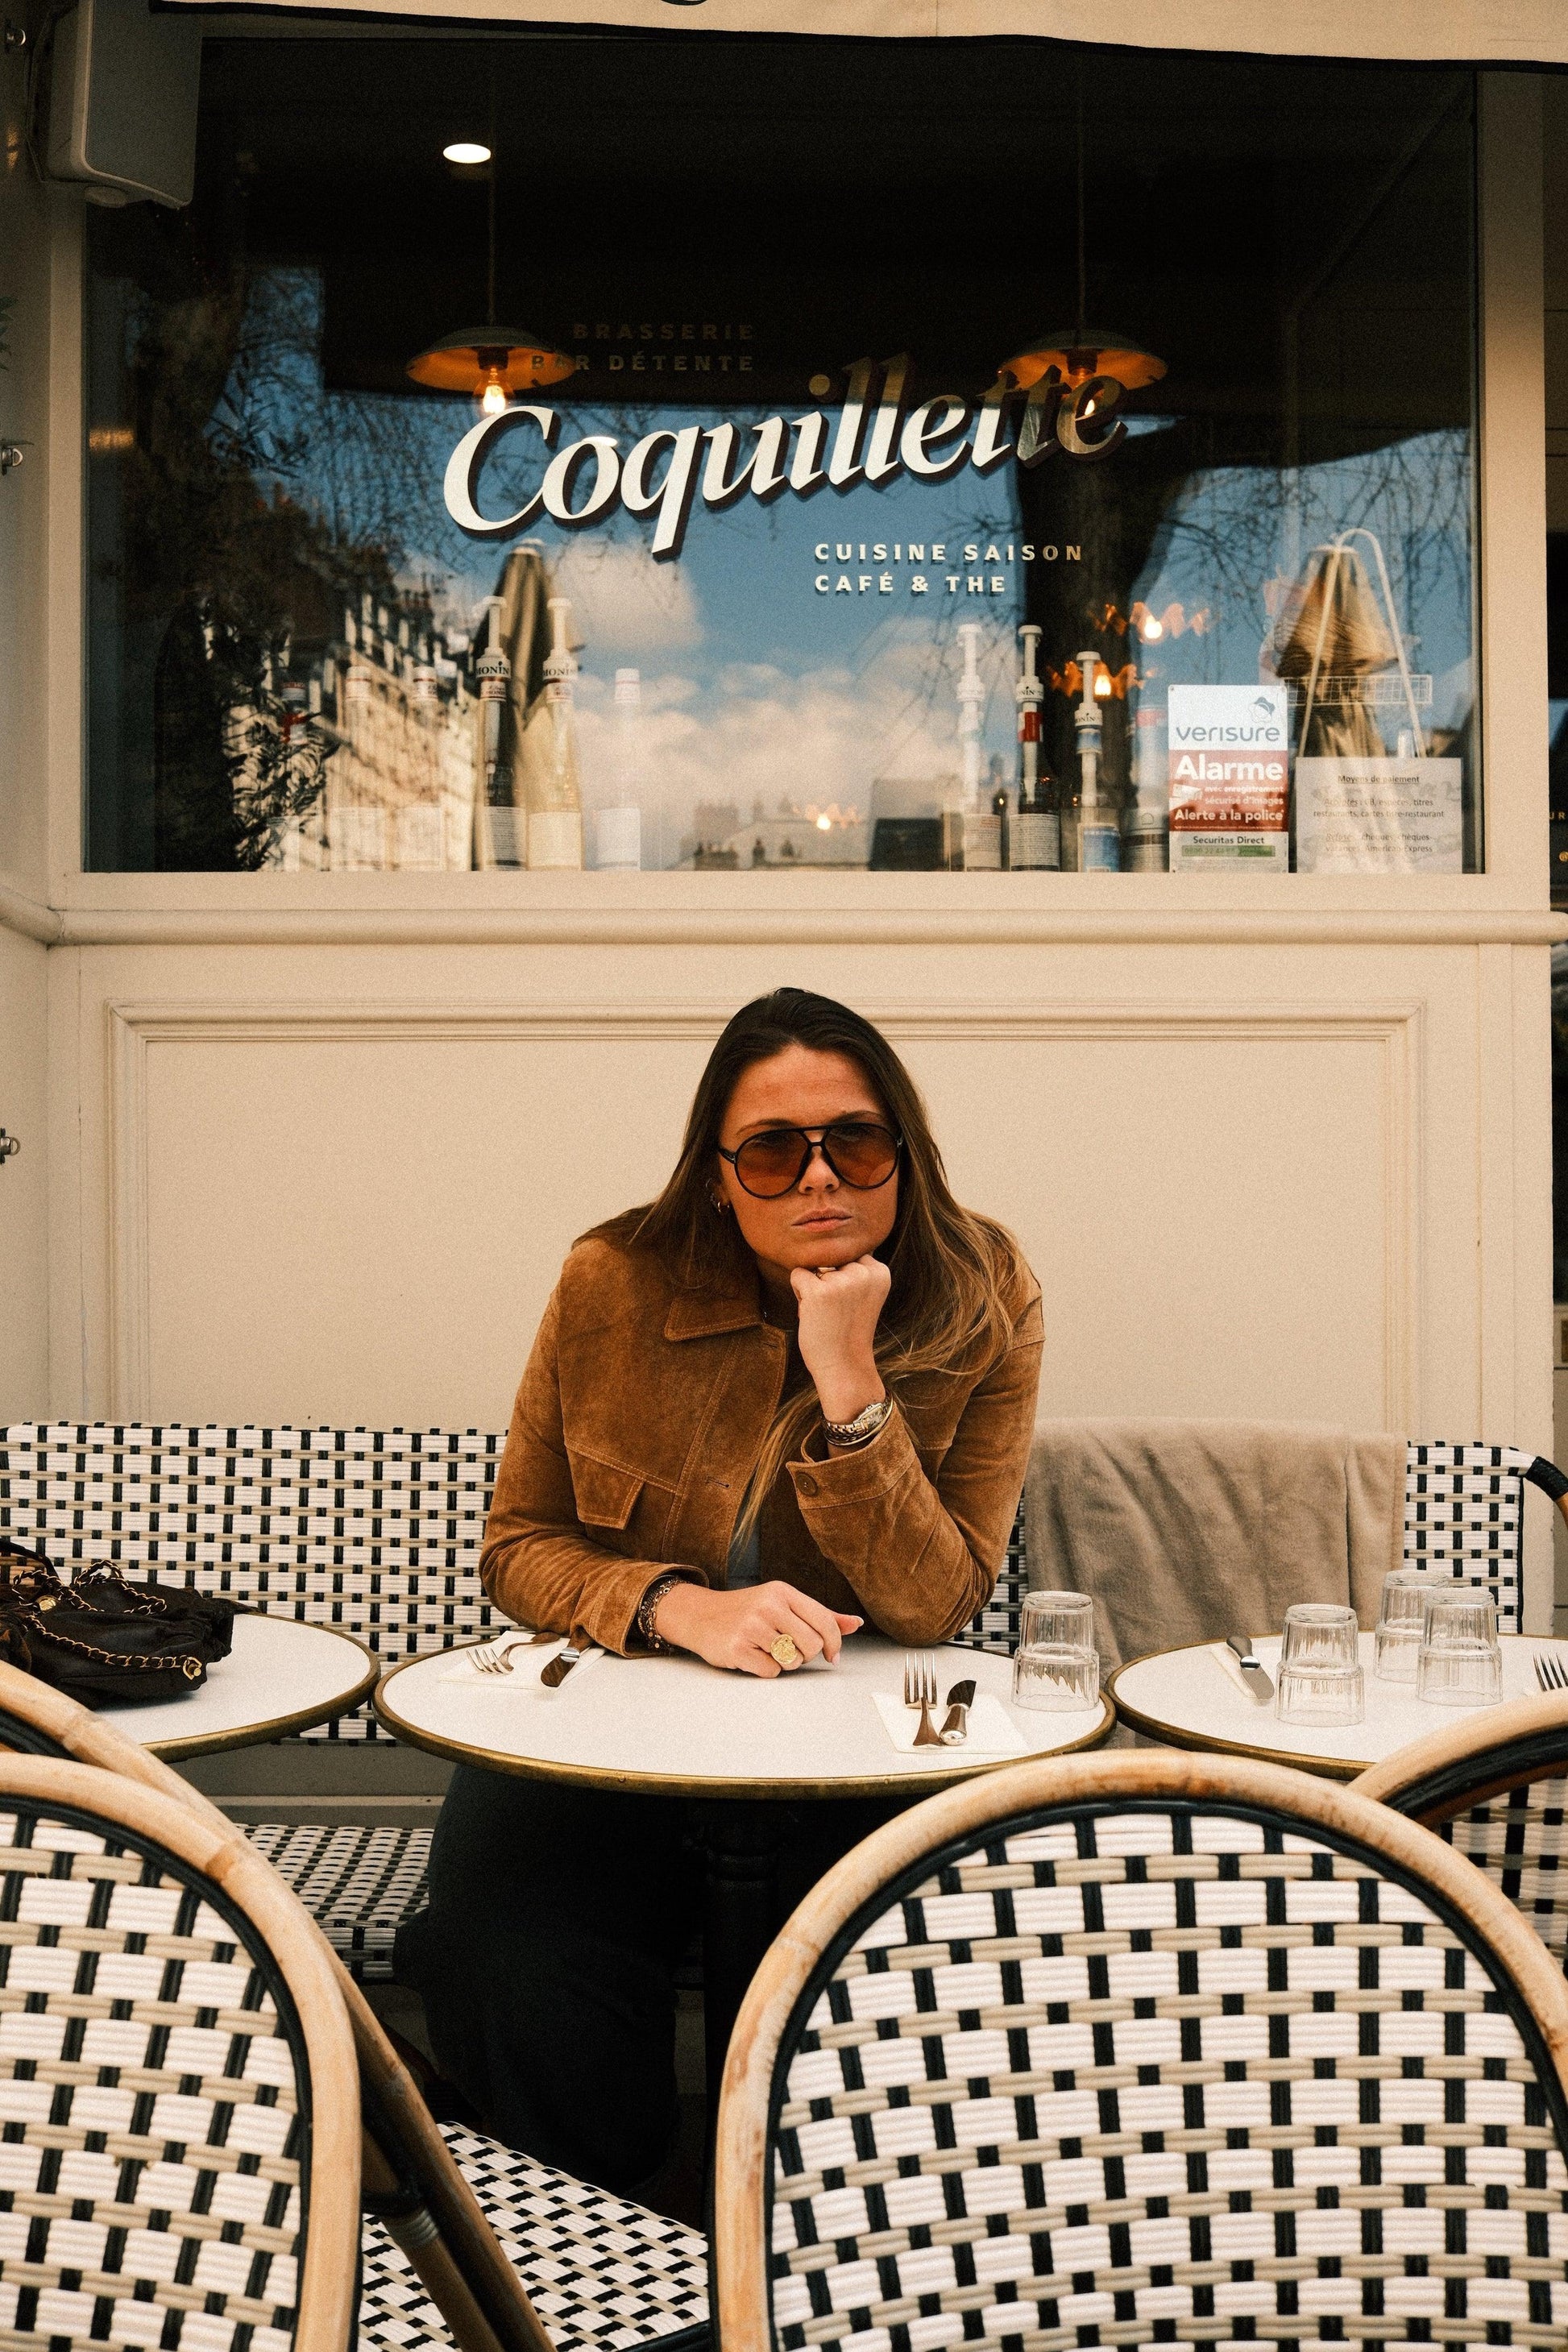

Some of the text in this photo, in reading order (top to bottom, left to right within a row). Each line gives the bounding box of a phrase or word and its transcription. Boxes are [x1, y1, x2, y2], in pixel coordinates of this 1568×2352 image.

[573, 323, 753, 339] BRASSERIE
[532, 351, 753, 371] BAR DÉTENTE
[442, 351, 1128, 558] Coquillette
[815, 543, 1082, 562] CUISINE SAISON
[815, 571, 1005, 592] CAFÉ & THE
[1176, 727, 1280, 741] verisure
[1174, 753, 1284, 780] Alarme
[1338, 775, 1369, 784] Moyens
[1383, 775, 1420, 784] paiement
[1224, 785, 1284, 794] enregistrement
[1175, 809, 1216, 820] Alerte
[1219, 809, 1227, 820] à
[1230, 809, 1241, 820] la
[1193, 836, 1264, 844] Securitas Direct
